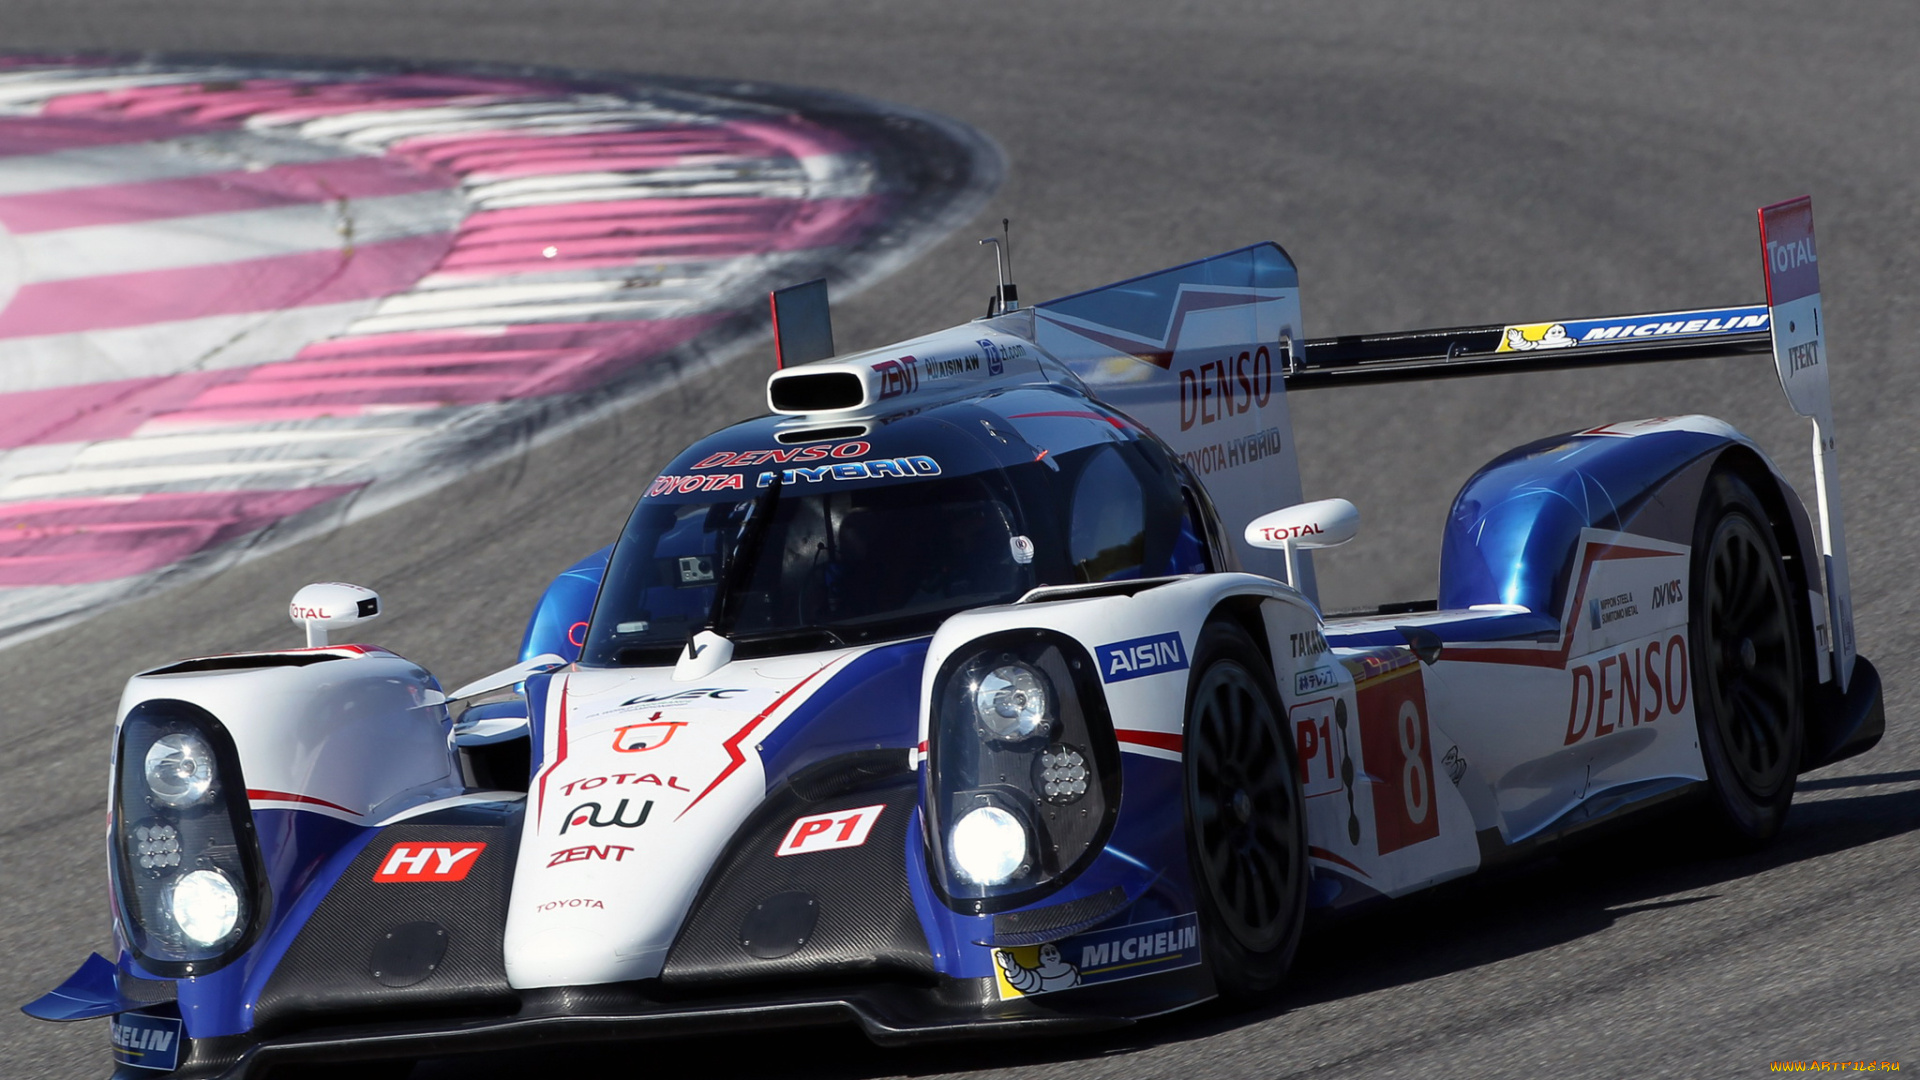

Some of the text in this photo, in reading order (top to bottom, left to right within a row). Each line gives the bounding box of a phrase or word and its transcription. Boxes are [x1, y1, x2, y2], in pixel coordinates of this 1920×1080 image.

[1766, 238, 1817, 274] TOTAL
[1582, 315, 1768, 341] MICHELIN
[938, 358, 964, 378] AISIN
[965, 354, 979, 372] AW
[1788, 340, 1819, 378] JTEKT
[871, 355, 918, 400] ZENT
[1179, 346, 1271, 432] DENSO
[690, 441, 871, 470] DENSO
[1227, 426, 1281, 468] HYBRID
[643, 455, 942, 498] TOYOTA HYBRID
[1260, 523, 1324, 541] TOTAL
[1110, 640, 1180, 675] AISIN
[1564, 634, 1687, 746] DENSO
[1297, 716, 1335, 784] P1
[1398, 700, 1428, 824] 8
[559, 773, 690, 796] TOTAL
[789, 813, 863, 849] P1
[381, 848, 479, 875] HY
[546, 845, 635, 868] ZENT
[536, 898, 605, 913] TOYOTA
[1081, 926, 1196, 968] MICHELIN
[112, 1024, 174, 1052] HELIN
